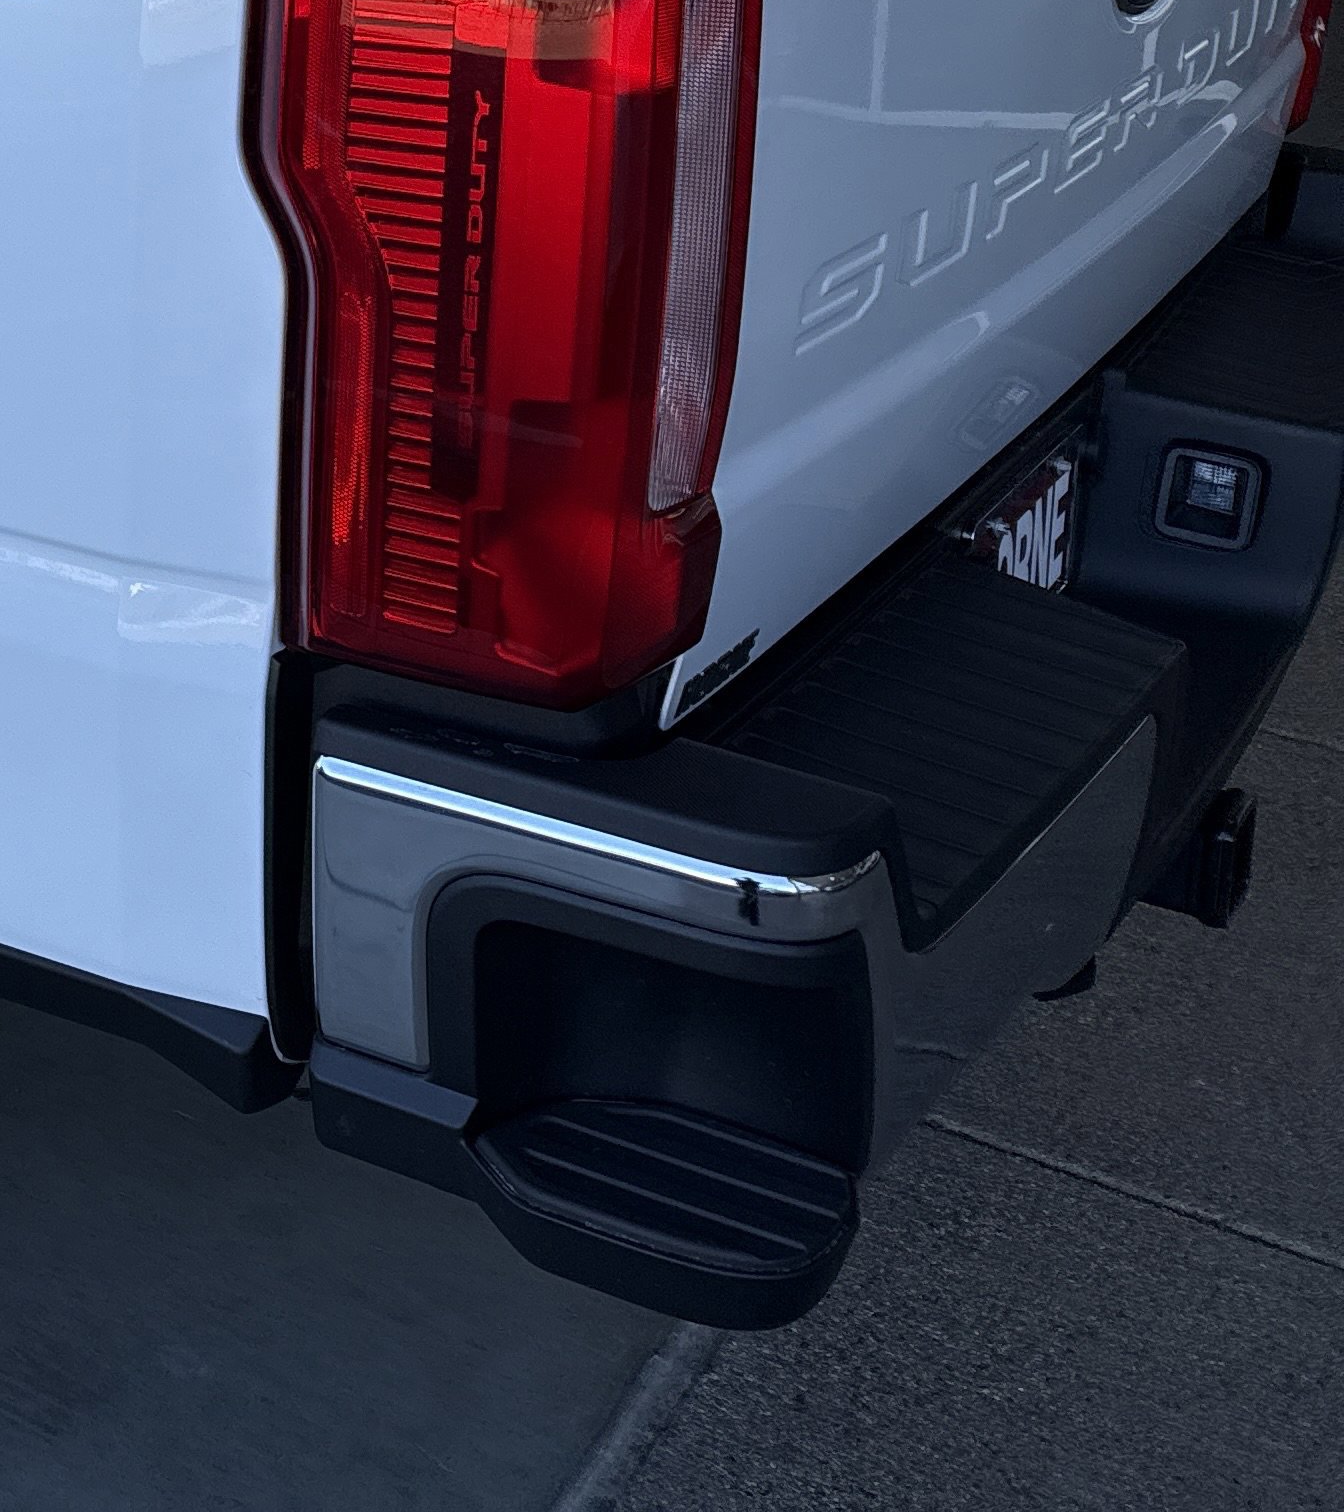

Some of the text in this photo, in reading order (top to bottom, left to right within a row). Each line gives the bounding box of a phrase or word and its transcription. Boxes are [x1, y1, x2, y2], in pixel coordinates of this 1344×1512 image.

[456, 88, 491, 449] SUPER DUTY
[794, 65, 1163, 356] SUPER
